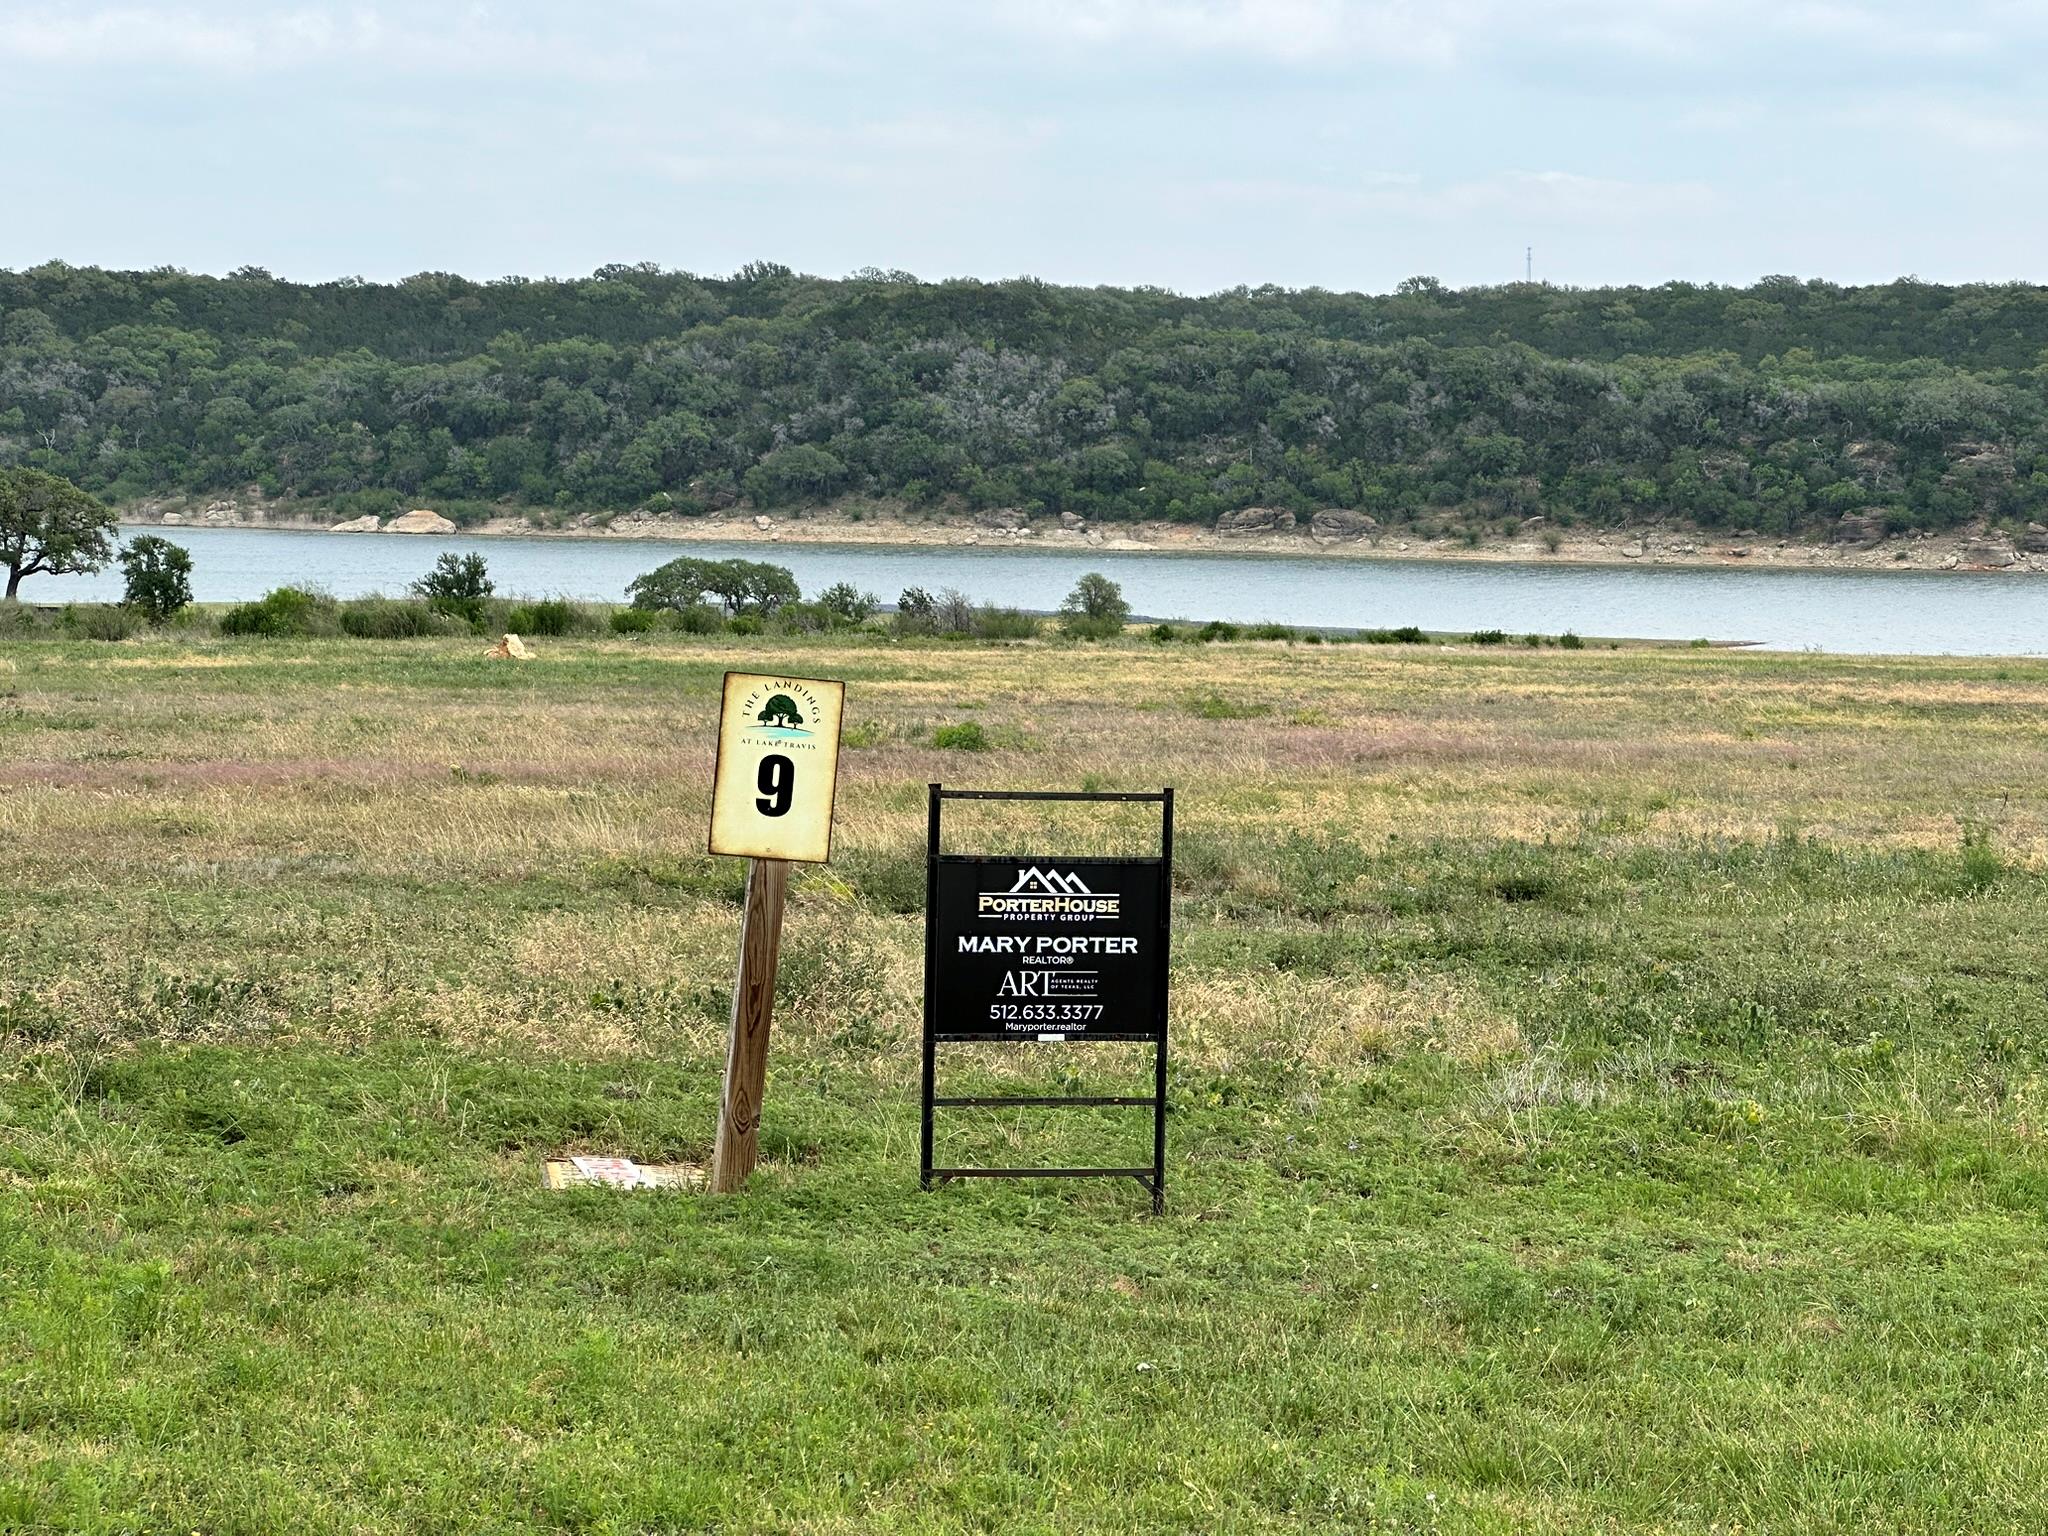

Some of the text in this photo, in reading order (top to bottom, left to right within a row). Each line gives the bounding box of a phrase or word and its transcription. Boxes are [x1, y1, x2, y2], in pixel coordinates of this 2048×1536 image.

[742, 680, 821, 724] THE LANDINGS
[756, 739, 779, 747] LAKE
[784, 741, 817, 750] TRAVIS
[755, 753, 795, 818] 9
[1003, 912, 1096, 922] PROPERTY GROUP
[957, 935, 1139, 955] MARY PORTER
[996, 969, 1057, 997] ART
[989, 1004, 1104, 1020] 512.633.3377
[1005, 1022, 1087, 1032] Maryporter.realtor
